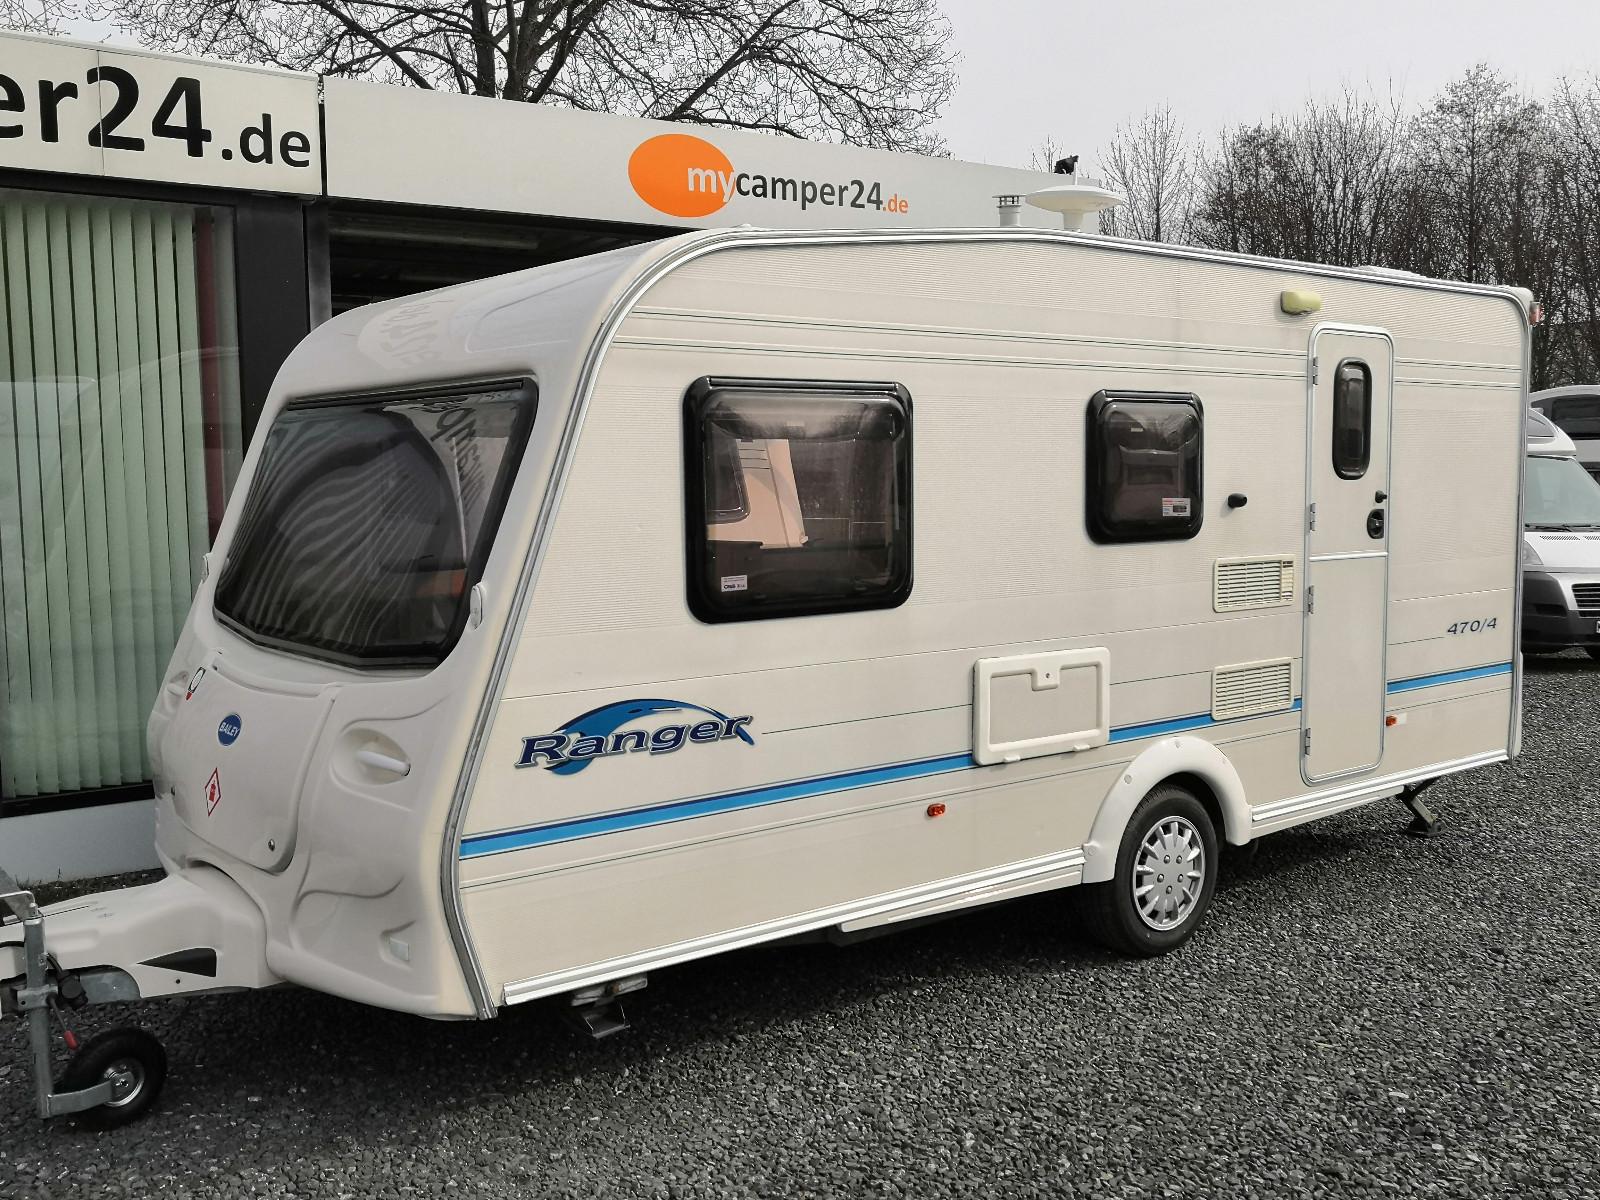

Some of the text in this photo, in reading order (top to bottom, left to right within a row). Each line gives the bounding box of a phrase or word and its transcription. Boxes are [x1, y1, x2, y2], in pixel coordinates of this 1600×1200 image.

[687, 167, 908, 213] mycamper24.de
[1447, 617, 1497, 635] 470/4
[219, 721, 240, 737] BAILEY
[514, 715, 754, 769] Ranger
